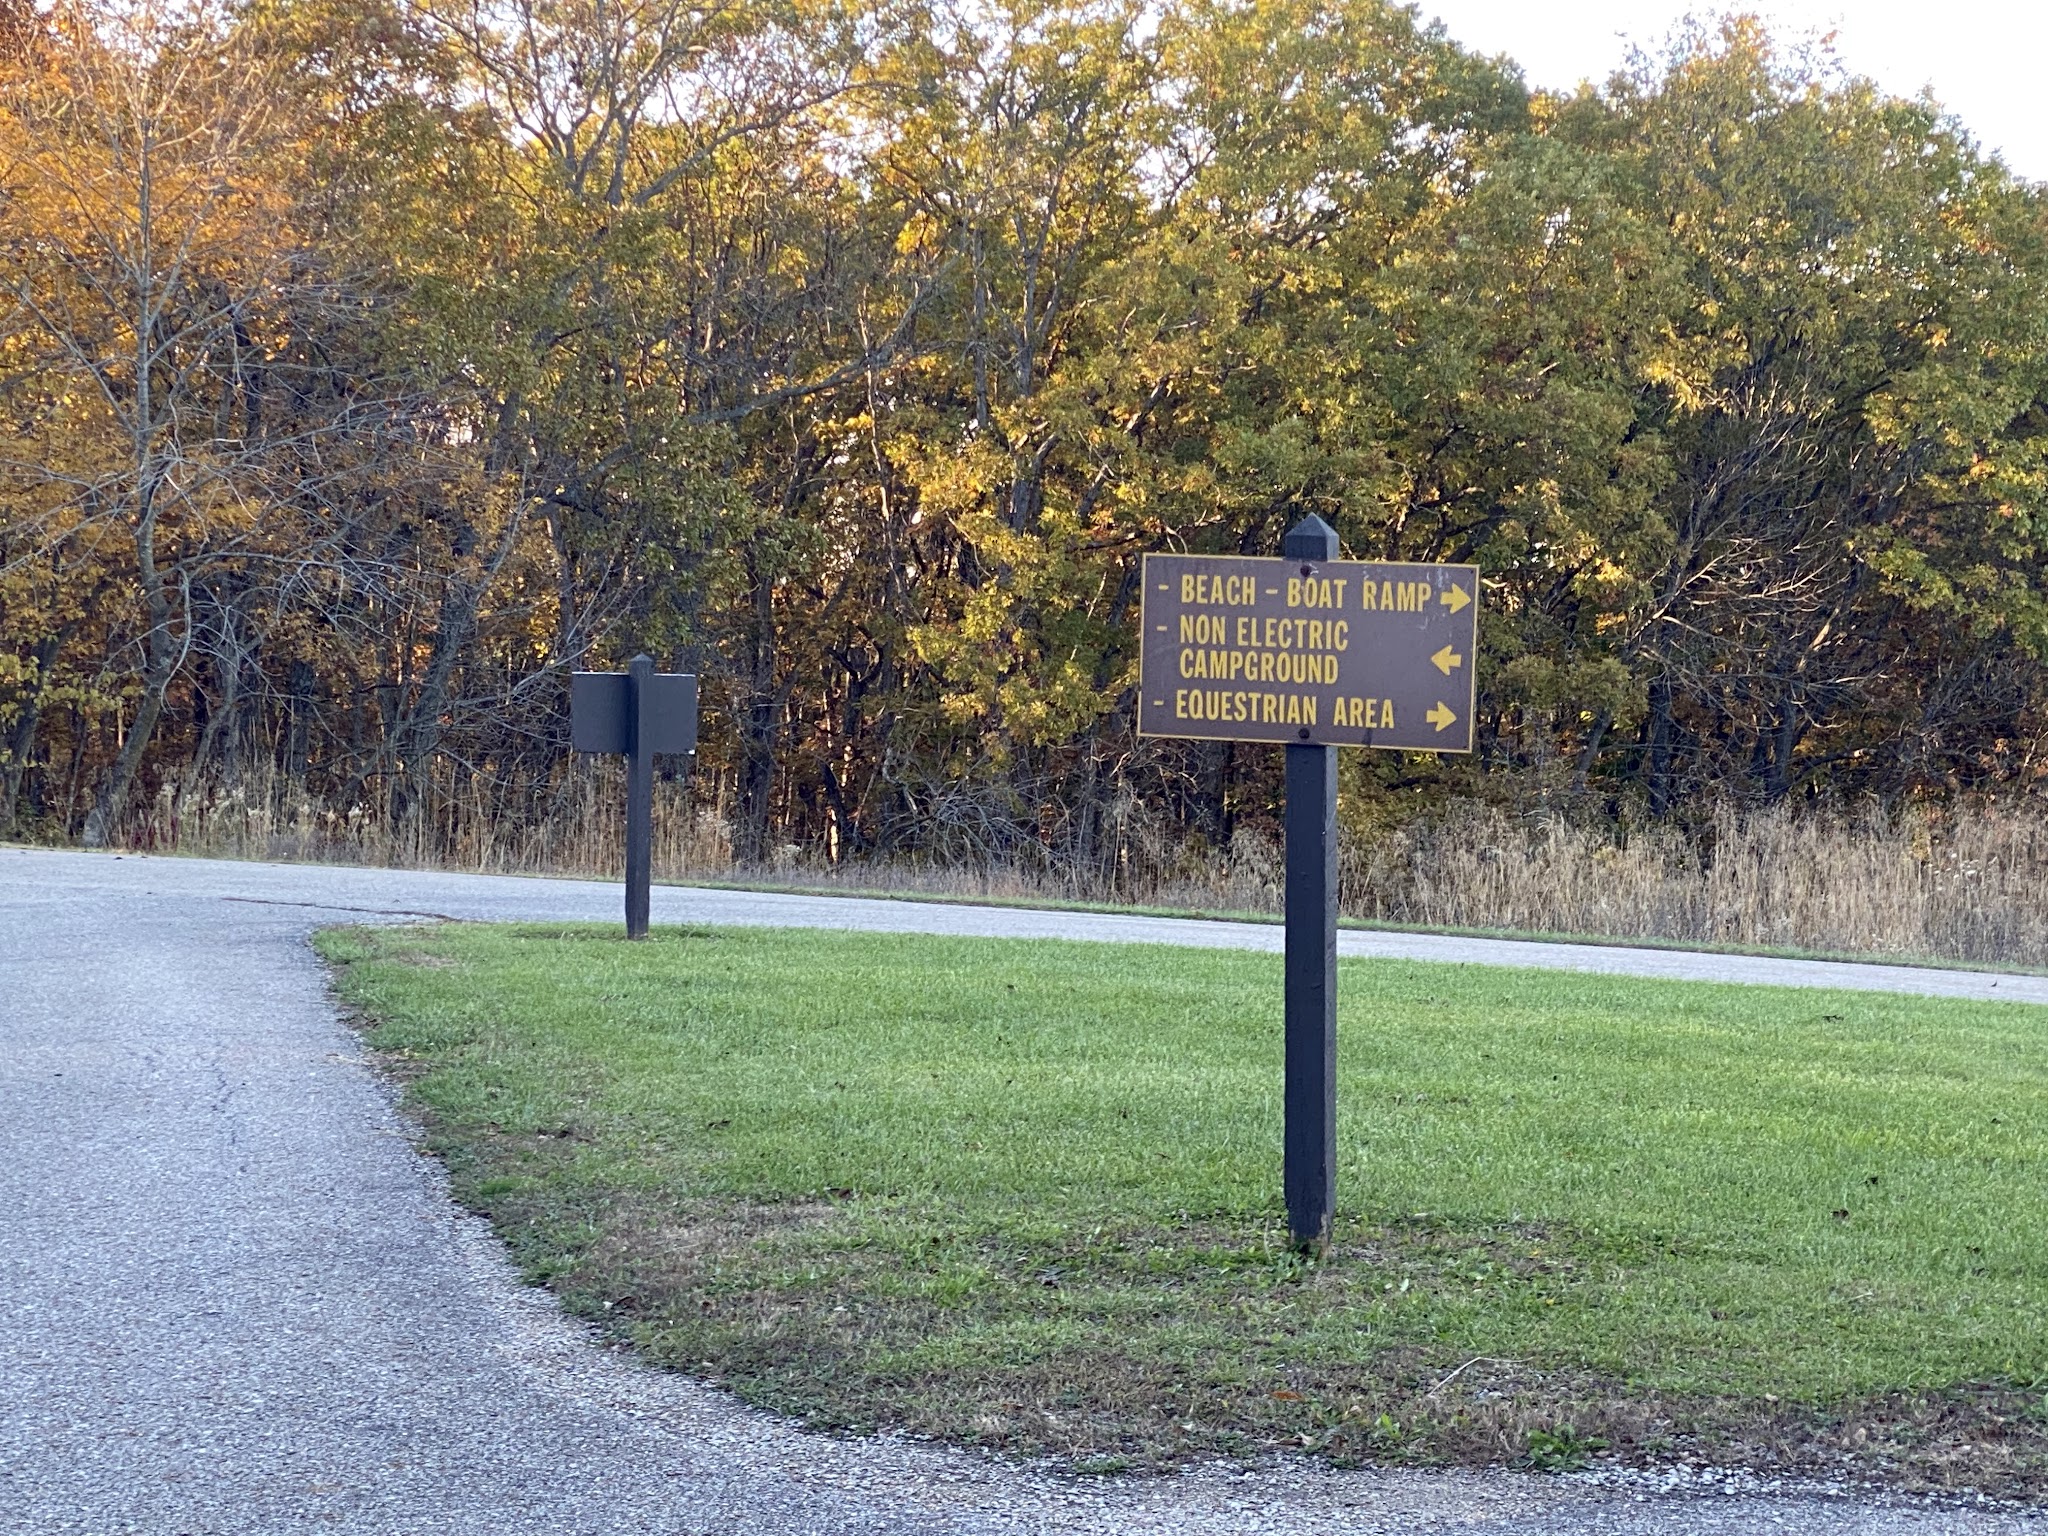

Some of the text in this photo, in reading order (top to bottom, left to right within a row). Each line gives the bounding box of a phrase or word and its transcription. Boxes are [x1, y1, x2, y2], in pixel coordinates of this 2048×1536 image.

[1181, 574, 1256, 606] BEACH
[1286, 577, 1347, 609] BOAT
[1362, 579, 1432, 612] RAMP
[1179, 614, 1227, 645] NON
[1237, 616, 1349, 651] ELECTRIC
[1179, 649, 1339, 684] CAMPGROUND
[1176, 689, 1317, 725] EQUESTRIAN
[1332, 696, 1395, 729] AREA
